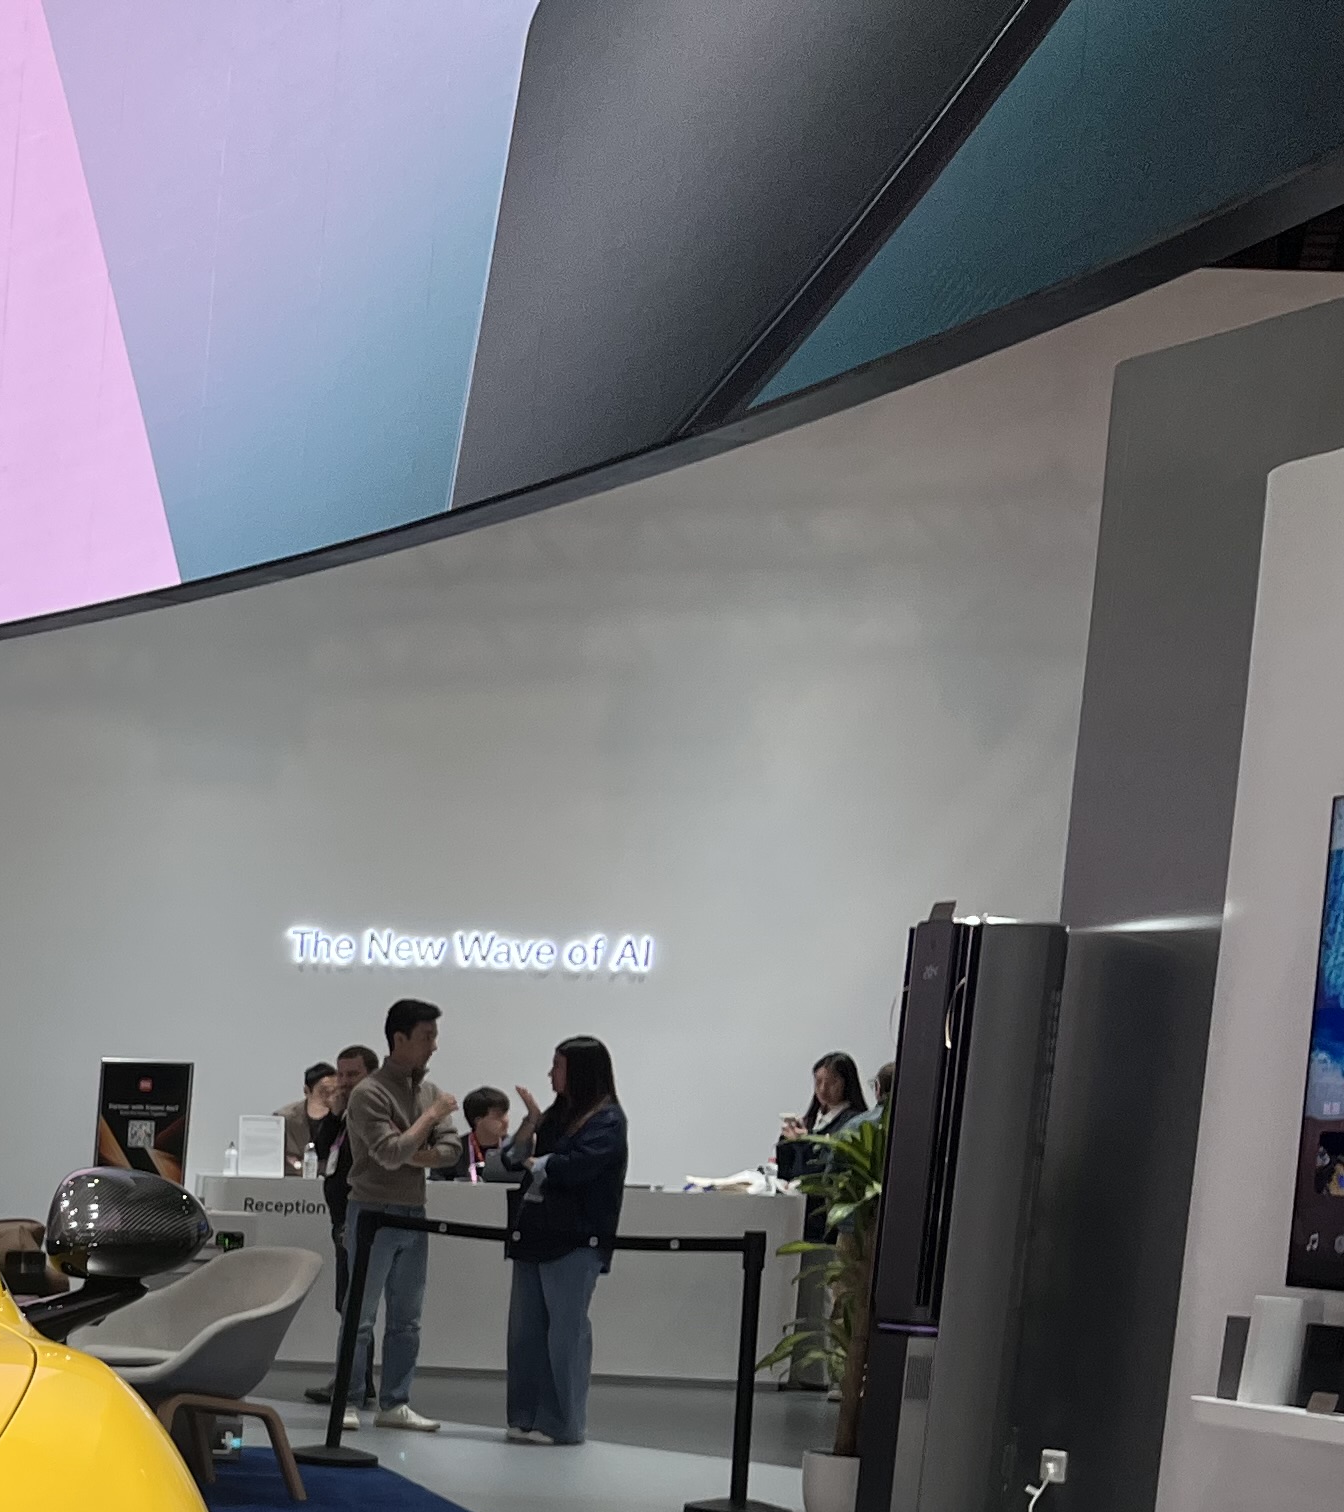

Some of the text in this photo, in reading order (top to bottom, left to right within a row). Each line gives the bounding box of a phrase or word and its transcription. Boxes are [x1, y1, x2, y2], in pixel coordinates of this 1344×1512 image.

[291, 928, 652, 969] The New Wave of AI
[243, 1197, 326, 1217] Reception
